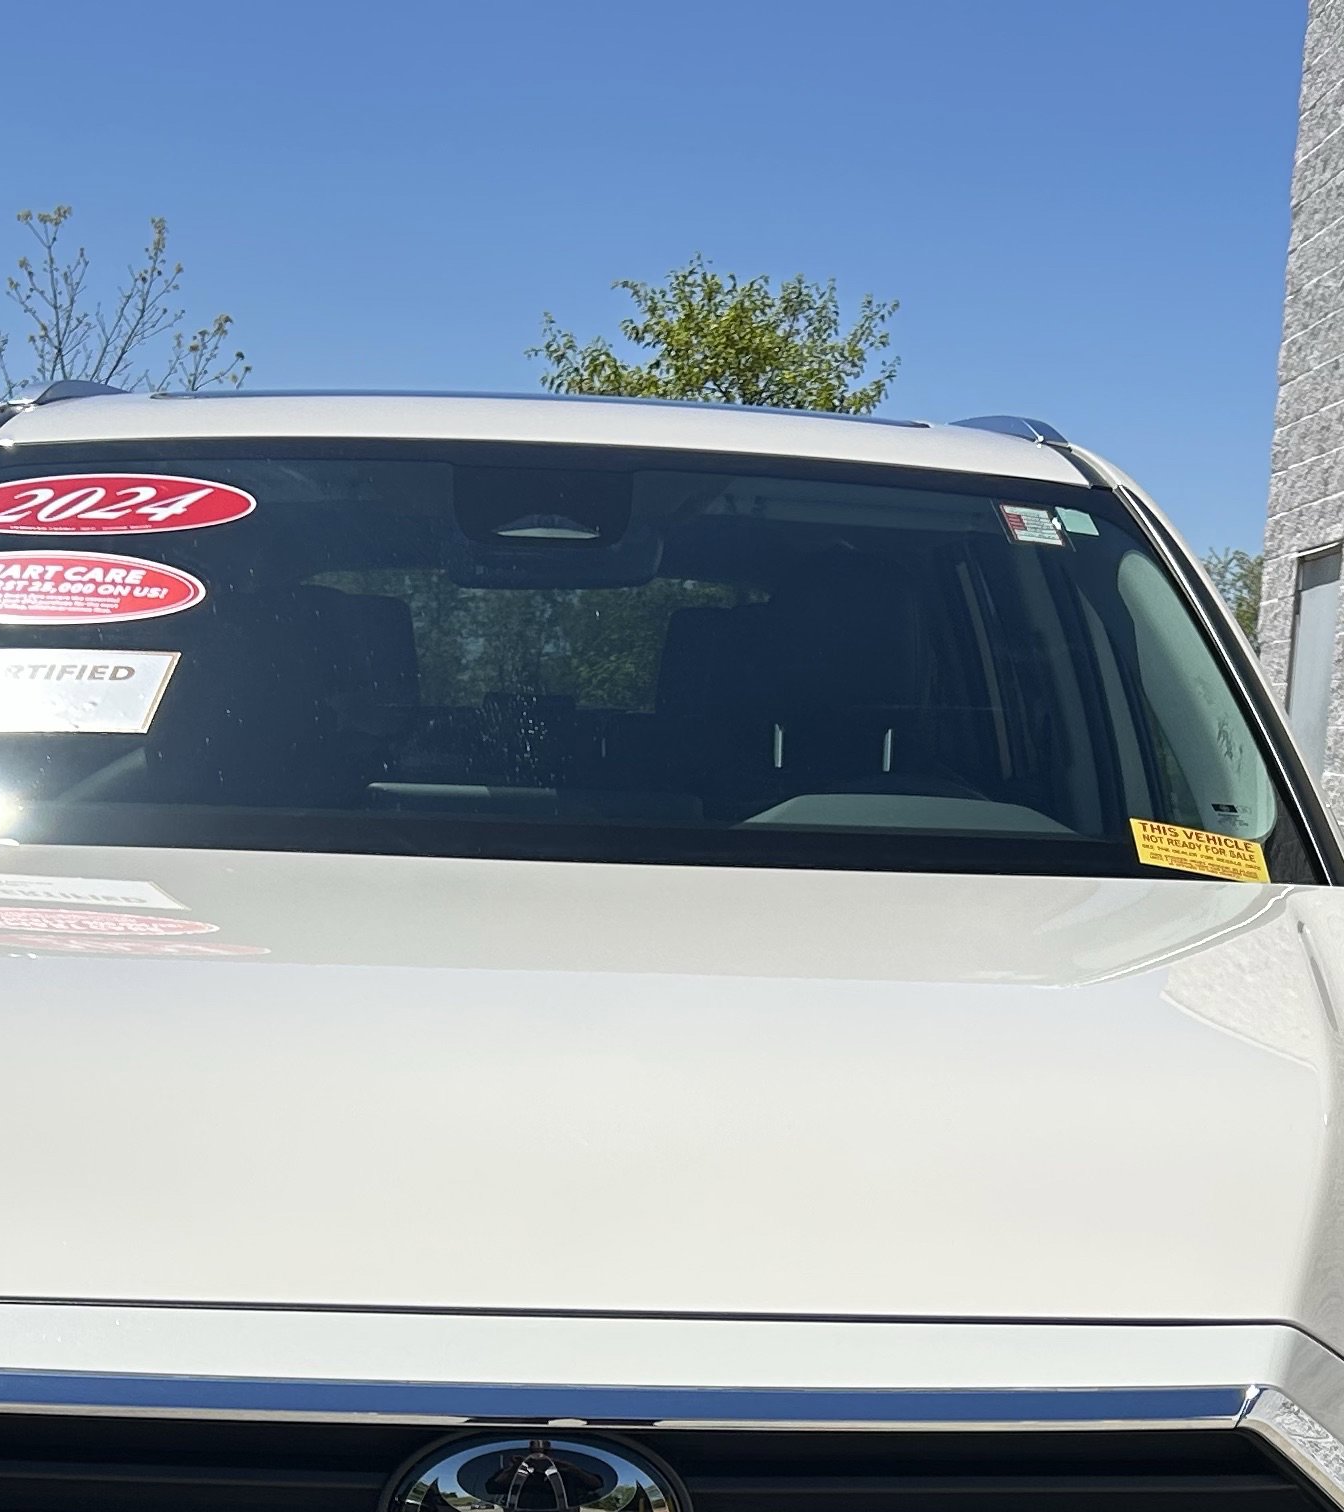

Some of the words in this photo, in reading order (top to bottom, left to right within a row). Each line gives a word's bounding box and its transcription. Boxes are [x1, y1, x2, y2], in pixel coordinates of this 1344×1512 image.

[63, 565, 147, 585] CARE
[97, 583, 131, 597] ON
[132, 586, 169, 600] US!
[1137, 821, 1179, 838] THIS
[1182, 829, 1256, 853] VEHICLE
[1142, 833, 1164, 845] NOT
[1166, 837, 1202, 852] READY
[1204, 844, 1227, 857] FOR
[1229, 849, 1257, 864] SALE
